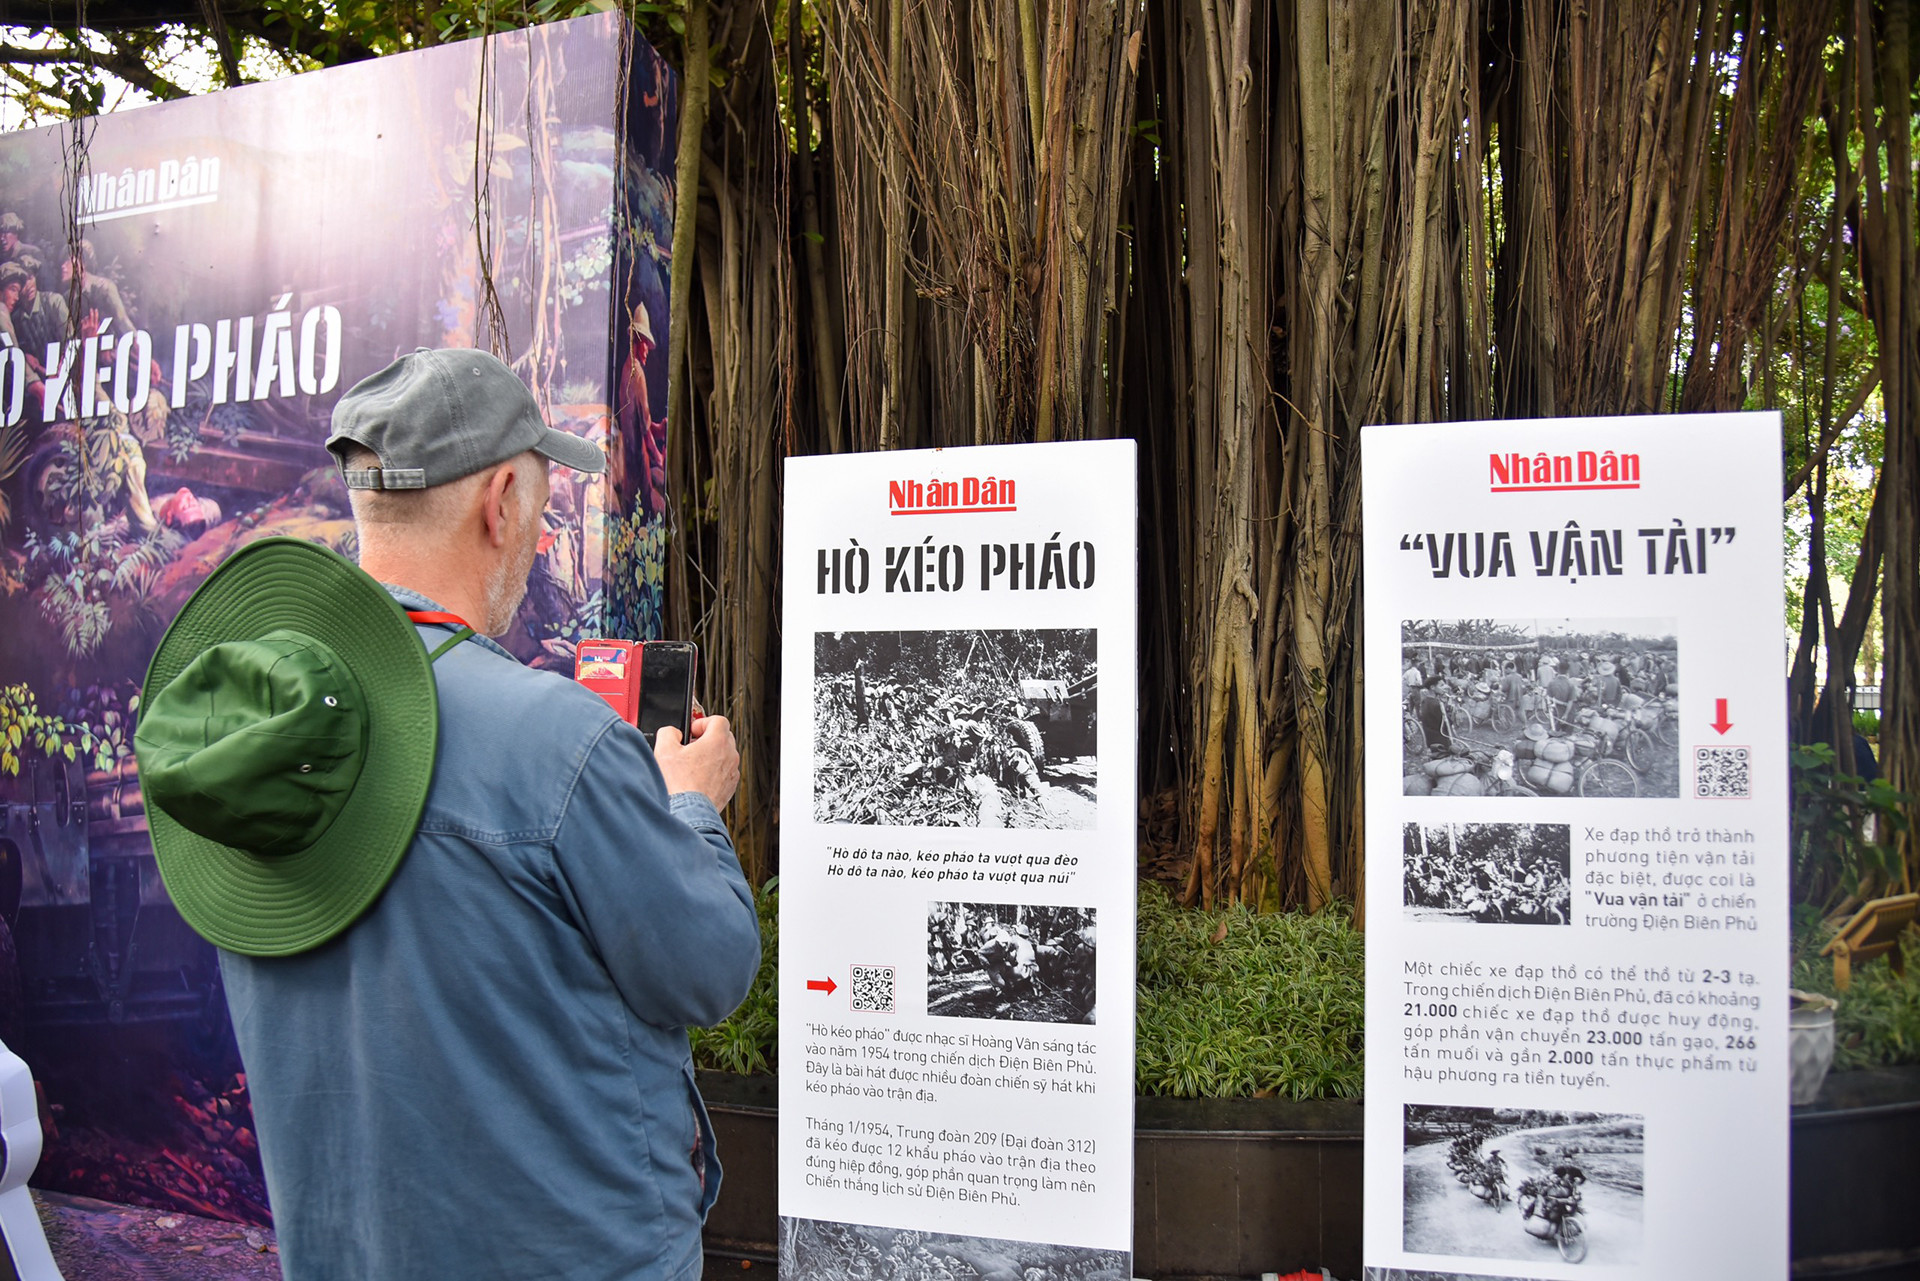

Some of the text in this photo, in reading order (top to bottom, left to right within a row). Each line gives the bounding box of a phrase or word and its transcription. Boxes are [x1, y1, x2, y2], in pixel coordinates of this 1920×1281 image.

[43, 317, 152, 422] KÉO
[171, 292, 342, 409] PHÁO
[817, 531, 1095, 594] HÒ KÉO PHÁO
[1529, 520, 1623, 584] VẬN
[852, 848, 868, 859] dô
[871, 849, 883, 860] ta
[886, 849, 912, 862] nào,
[916, 850, 940, 862] kéo
[942, 851, 974, 865] pháo
[978, 852, 990, 863] ta
[994, 854, 1023, 867] vượt
[1026, 856, 1050, 867] qua
[1054, 854, 1078, 866] đèo
[827, 864, 844, 876] Hò
[847, 865, 862, 877] dô
[866, 866, 878, 877] ta
[881, 866, 906, 879] nào,
[911, 867, 934, 879] kéo
[937, 868, 969, 882] pháo
[972, 870, 985, 881] ta
[989, 871, 1017, 884] vượt
[1020, 873, 1044, 885] qua
[1628, 892, 1658, 910] vận
[1697, 893, 1707, 908] ở
[1711, 893, 1756, 909] chiến
[1404, 960, 1433, 978] Một
[1440, 960, 1482, 977] chiếc
[1489, 966, 1507, 978] xe
[1514, 964, 1544, 983] đạp
[1551, 963, 1577, 980] thồ
[1584, 966, 1604, 981] có
[1610, 965, 1637, 981] thể
[1644, 966, 1670, 982] thồ
[1678, 968, 1695, 983] từ
[1702, 969, 1731, 984] 2-3
[1403, 981, 1760, 1010] Trong chiến dịch Điện Biên Phủ, đã có khoảng
[1404, 1002, 1458, 1018] 21.000
[1462, 1003, 1509, 1020] chiếc
[1516, 1010, 1535, 1021] xe
[1542, 1007, 1575, 1026] đạp
[1582, 1007, 1610, 1023] thồ
[1617, 1010, 1660, 1027] được
[1668, 1012, 1700, 1030] huy
[831, 1025, 852, 1038] kéo
[893, 1029, 922, 1045] được
[926, 1031, 955, 1047] nhạc
[958, 1034, 969, 1046] sĩ
[972, 1034, 1012, 1053] Hoàng
[1015, 1037, 1039, 1050] Vân
[1043, 1039, 1074, 1056] sáng
[1077, 1041, 1096, 1054] tác
[1404, 1023, 1433, 1042] góp
[1439, 1023, 1480, 1043] phần
[1485, 1027, 1514, 1043] vận
[1520, 1027, 1581, 1046] chuyển
[1586, 1030, 1643, 1046] 23.000
[1649, 1031, 1676, 1047] tấn
[1725, 1035, 1757, 1050] 266
[805, 1042, 1096, 1074] vào năm 1954 trong chiến dịch Điện Biên Phủ.
[806, 1060, 829, 1078] Đây
[831, 1062, 842, 1076] là
[845, 1063, 863, 1077] bài
[866, 1065, 886, 1079] hát
[889, 1067, 919, 1084] được
[922, 1069, 957, 1084] nhiều
[960, 1072, 991, 1087] đoàn
[994, 1074, 1030, 1090] chiến
[1051, 1078, 1072, 1093] hát
[1076, 1080, 1095, 1094] khi
[806, 1079, 937, 1104] kéo pháo vào trận địa.
[1404, 1065, 1610, 1090] hậu phương ra tiền tuyến.
[805, 1116, 844, 1136] Tháng
[896, 1124, 935, 1144] Trung
[938, 1129, 970, 1144] đoàn
[974, 1131, 997, 1146] 209
[1030, 1136, 1064, 1151] đoàn
[805, 1136, 1096, 1174] đã kéo được 12 khẩu pháo vào trận địa theo
[805, 1155, 1096, 1193] đúng hiệp đồng, góp phần quan trọng làm nên
[806, 1173, 1020, 1206] Chiến thắng lịch sử Điện Biên Phủ.
